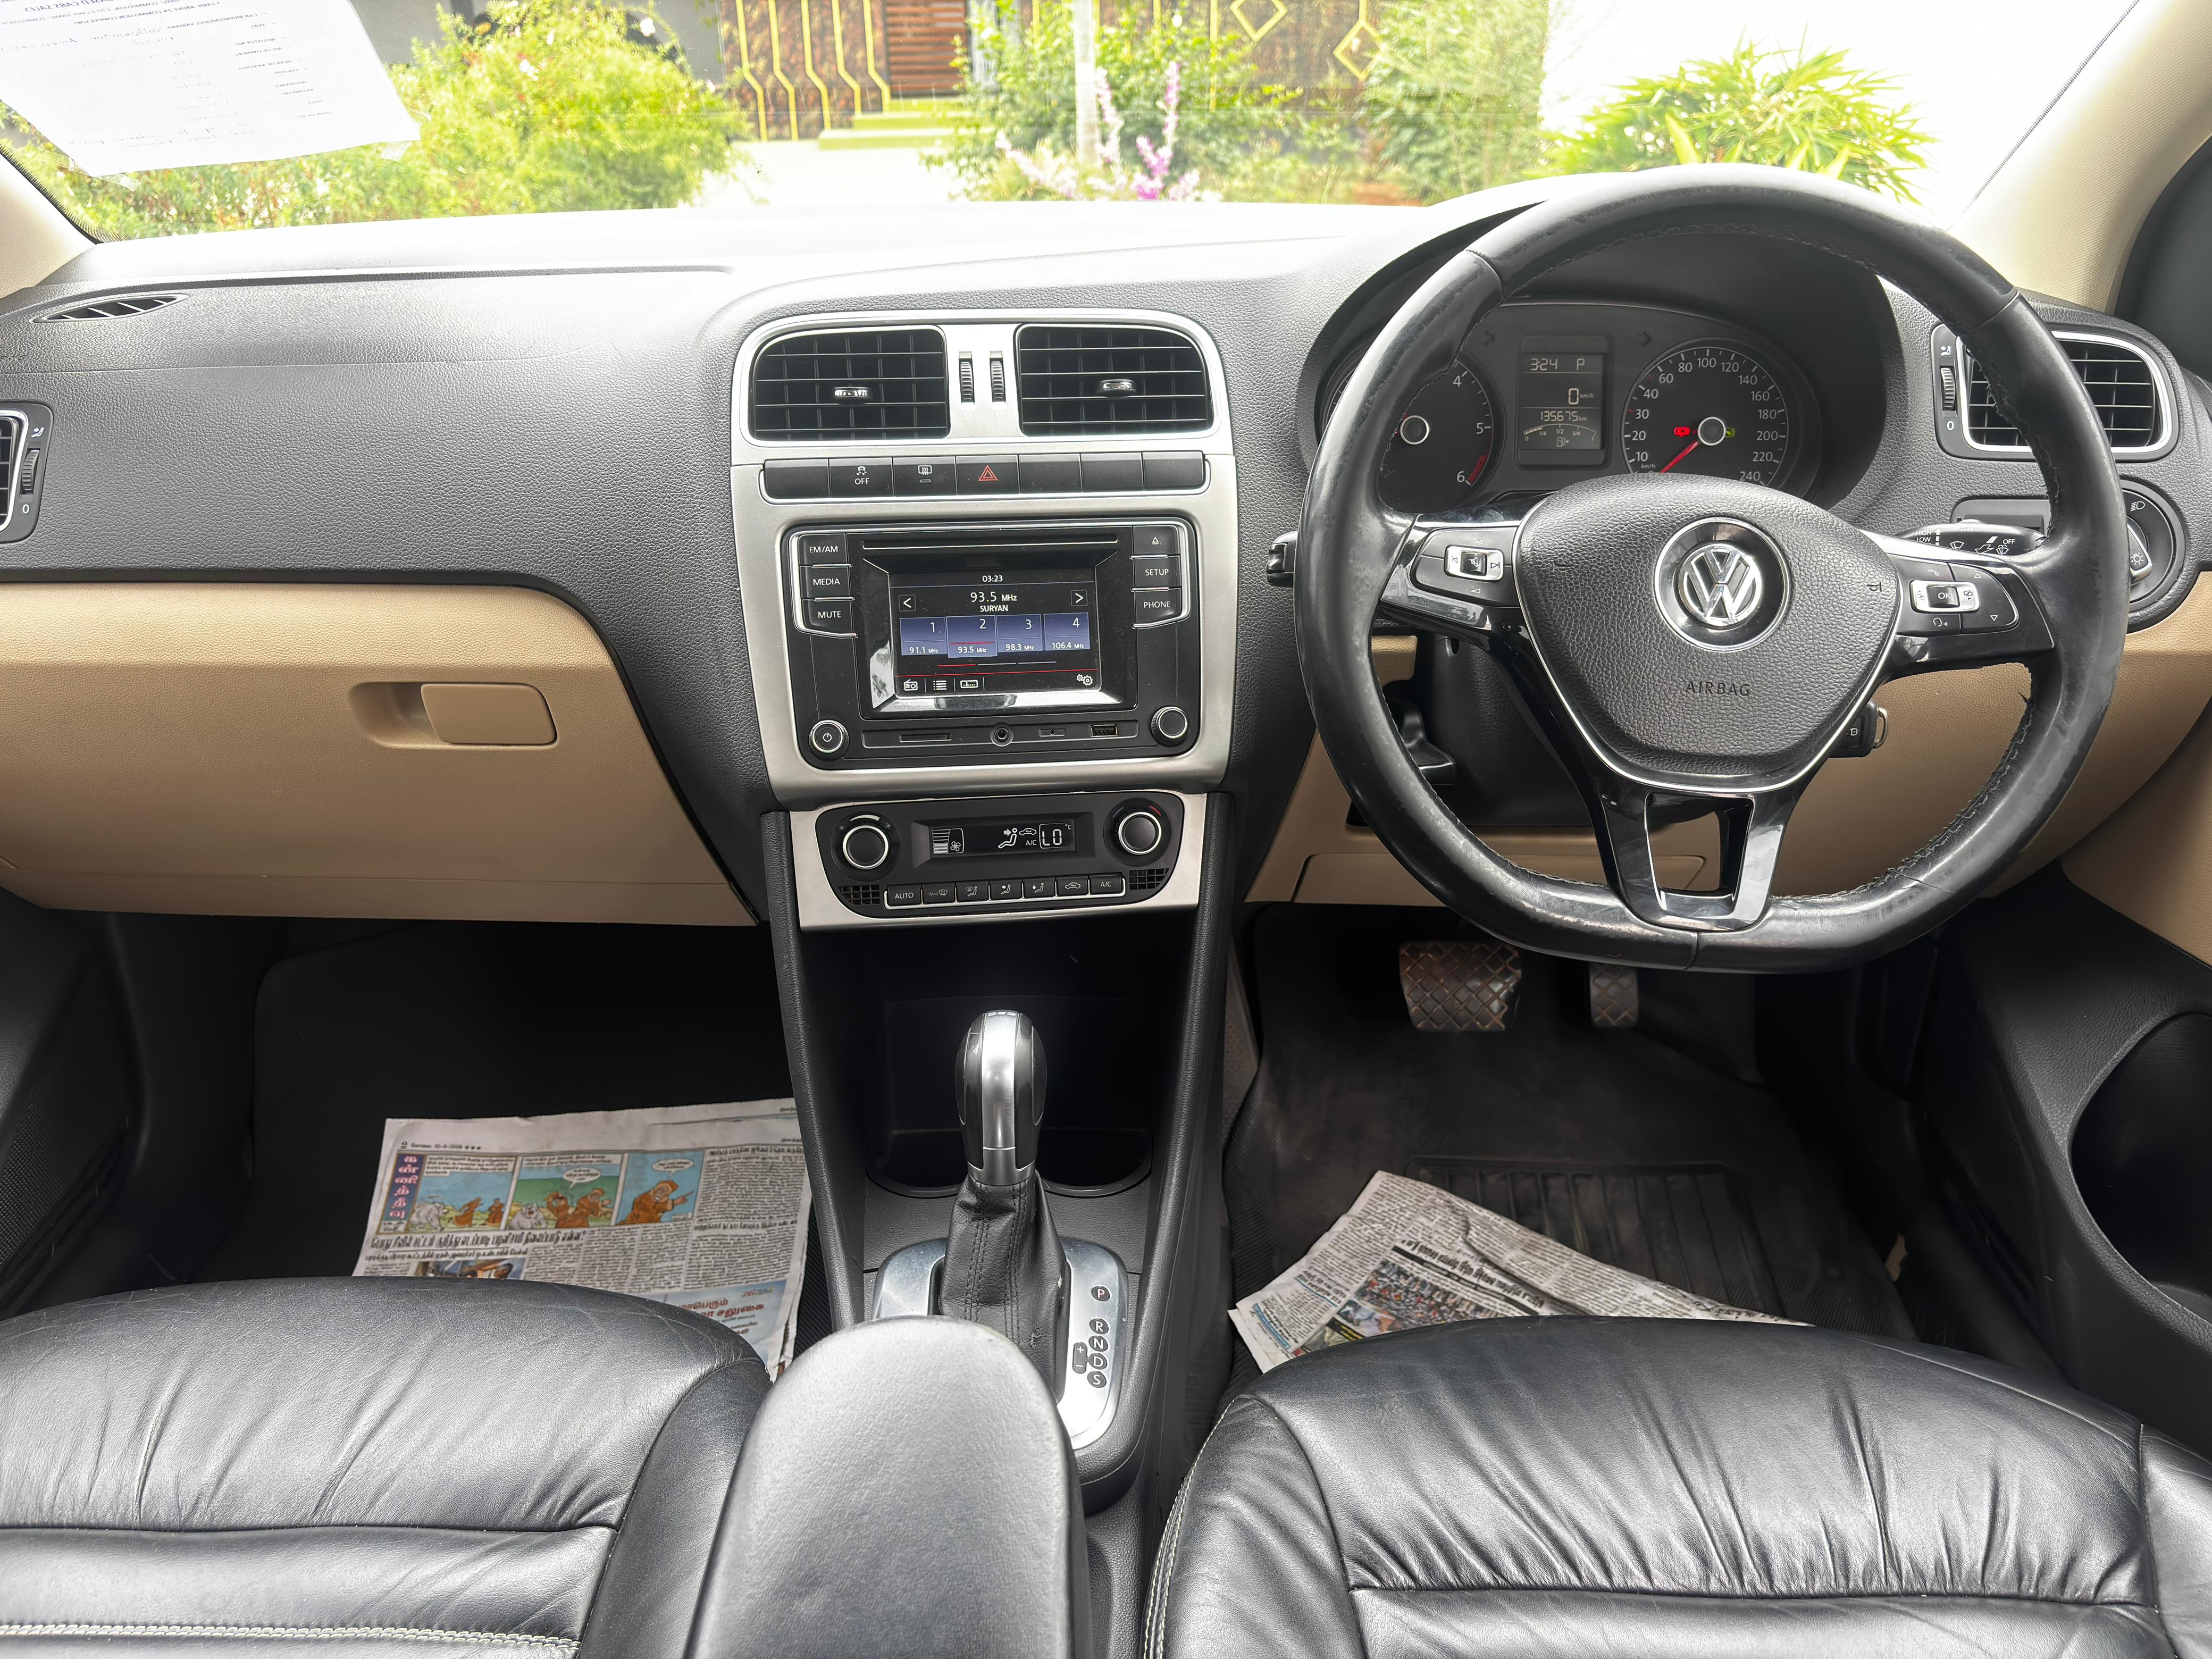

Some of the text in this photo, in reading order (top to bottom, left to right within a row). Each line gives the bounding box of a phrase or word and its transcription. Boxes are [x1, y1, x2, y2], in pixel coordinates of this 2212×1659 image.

[1531, 358, 1585, 371] 3:24 P
[1678, 362, 1692, 372] 80
[1697, 358, 1716, 368] 100
[1721, 362, 1739, 372] 120
[1453, 375, 1461, 387] 4
[1658, 373, 1673, 383] 60
[1739, 375, 1757, 385] 140
[1568, 388, 1579, 405] 0
[1643, 389, 1658, 399] 40
[1751, 391, 1770, 401] 160
[1541, 411, 1578, 421] 135675
[1636, 409, 1649, 419] 30
[1758, 409, 1777, 419] 180
[1476, 422, 1484, 434] 5
[1632, 431, 1646, 441] 20
[1756, 431, 1778, 441] 200
[1636, 452, 1648, 462] 10
[1753, 452, 1773, 462] 220
[1456, 471, 1465, 482] 6
[1740, 471, 1761, 481] 240
[970, 591, 997, 602] 93.5
[930, 622, 935, 632] 1
[979, 619, 986, 629] 2
[1025, 619, 1032, 630] 3
[1073, 618, 1079, 628] 4
[1686, 680, 1750, 697] AIRBAG
[1097, 1288, 1105, 1297] P
[1095, 1321, 1103, 1331] R
[1094, 1338, 1103, 1349] N
[1093, 1356, 1103, 1367] D
[1093, 1375, 1101, 1385] S
